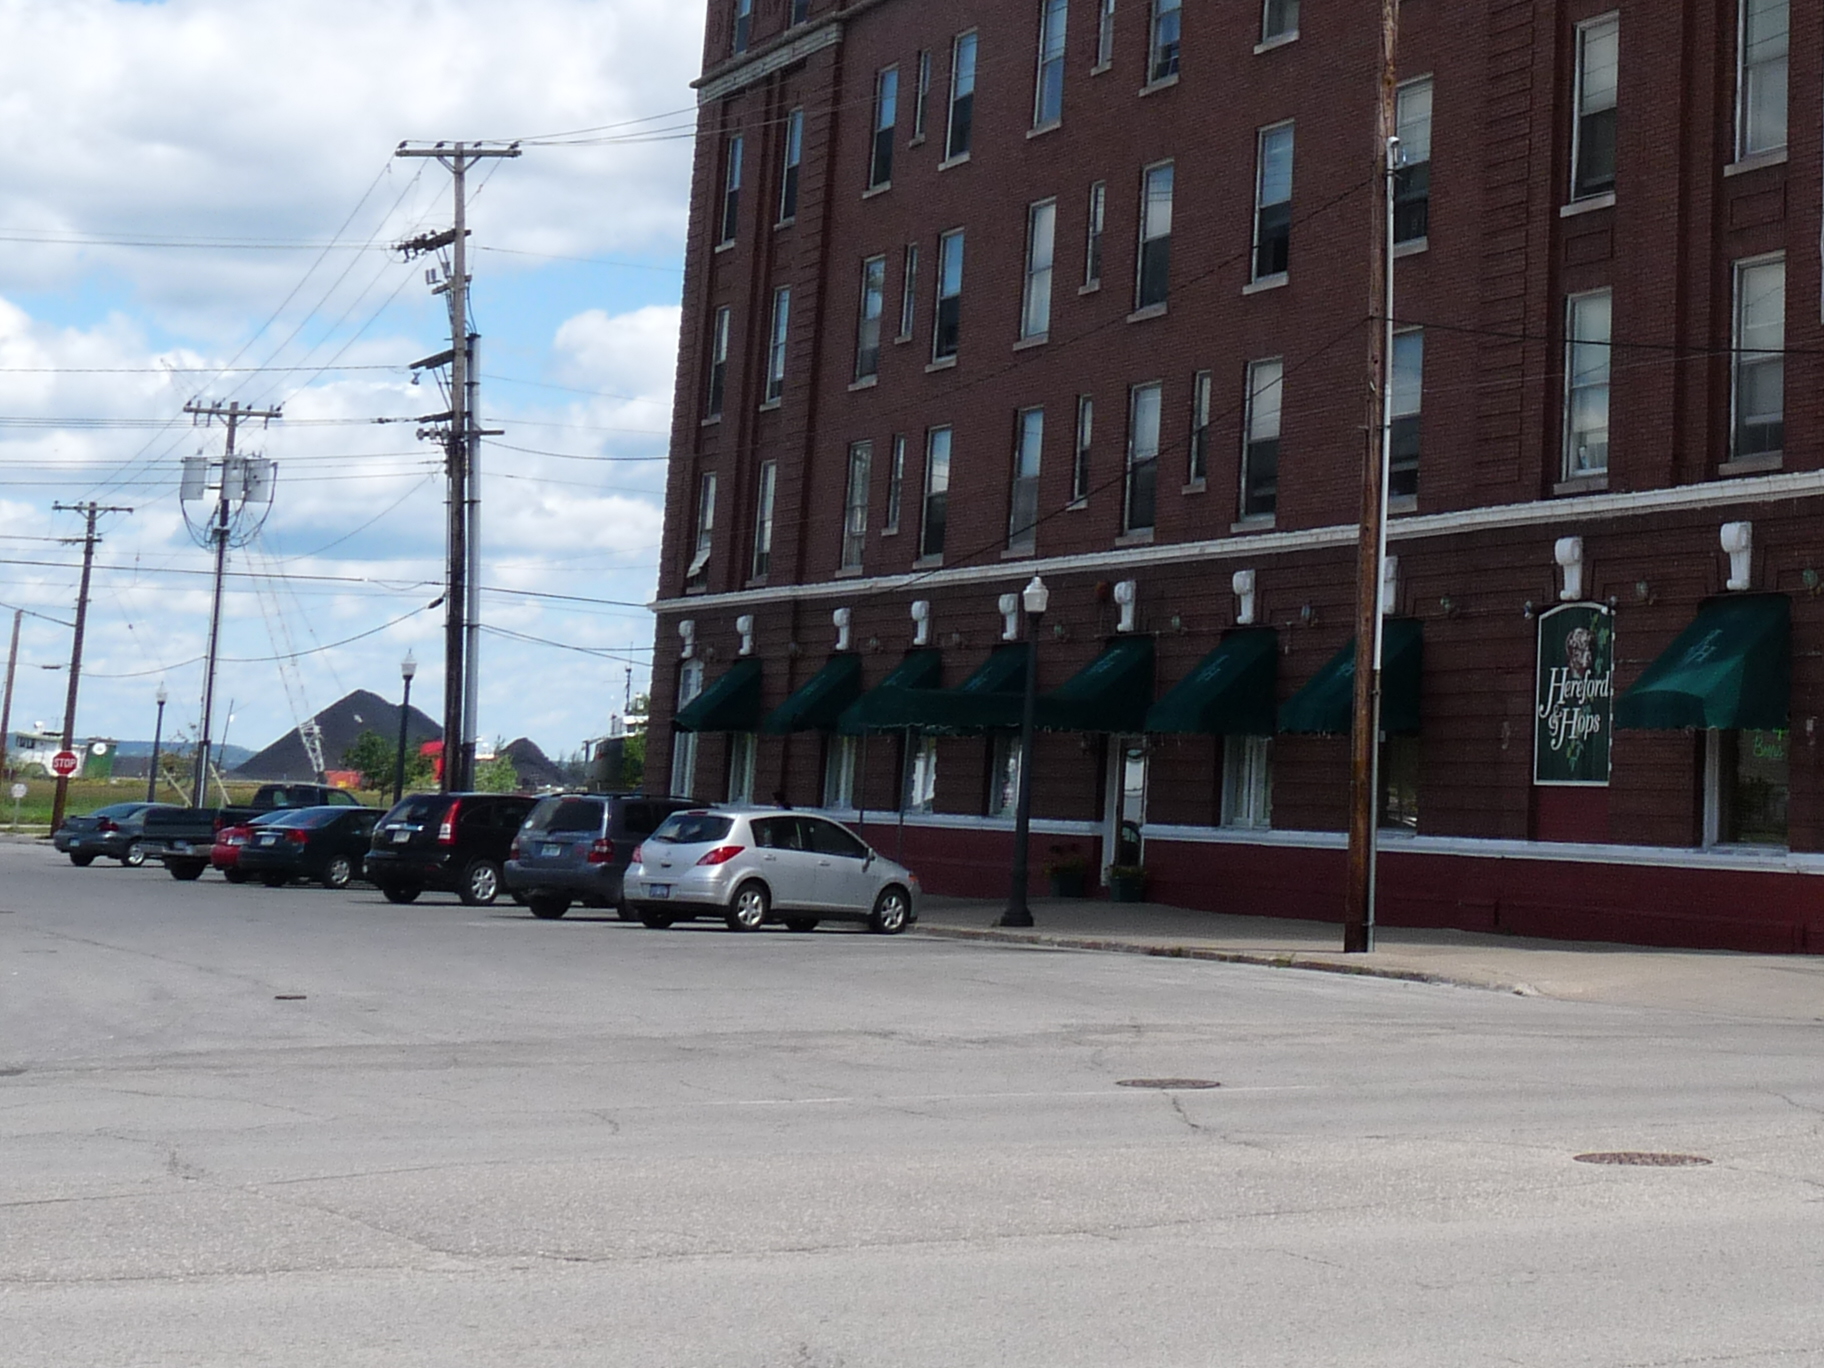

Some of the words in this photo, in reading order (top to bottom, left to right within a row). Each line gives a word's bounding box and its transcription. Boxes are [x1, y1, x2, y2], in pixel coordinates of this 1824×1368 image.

[1538, 666, 1610, 718] Hereford
[1551, 707, 1601, 751] Hops
[54, 758, 77, 768] STOP
